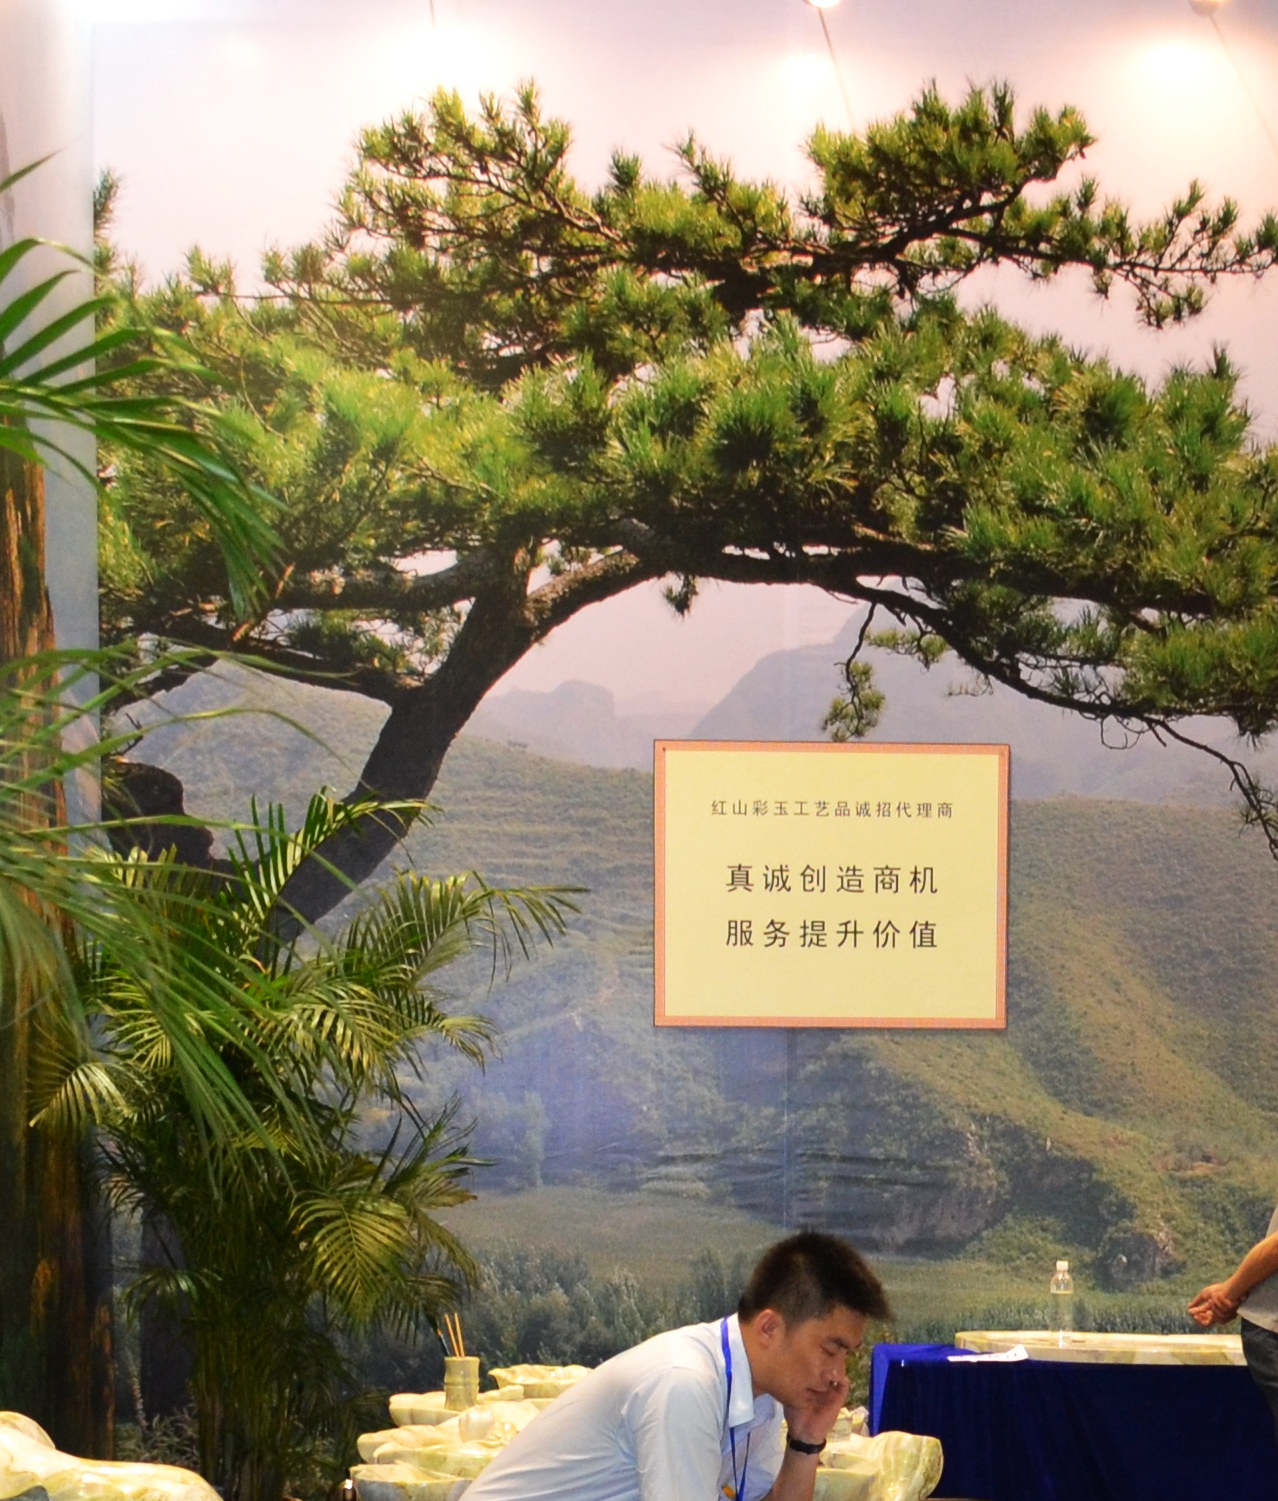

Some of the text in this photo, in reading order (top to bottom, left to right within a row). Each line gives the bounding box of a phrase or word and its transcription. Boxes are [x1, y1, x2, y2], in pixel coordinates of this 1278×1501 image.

[710, 798, 954, 820] 红山彩玉工艺品诚招代理商
[725, 862, 939, 895] 真诚创造商机
[725, 918, 939, 949] 服务提升价值
